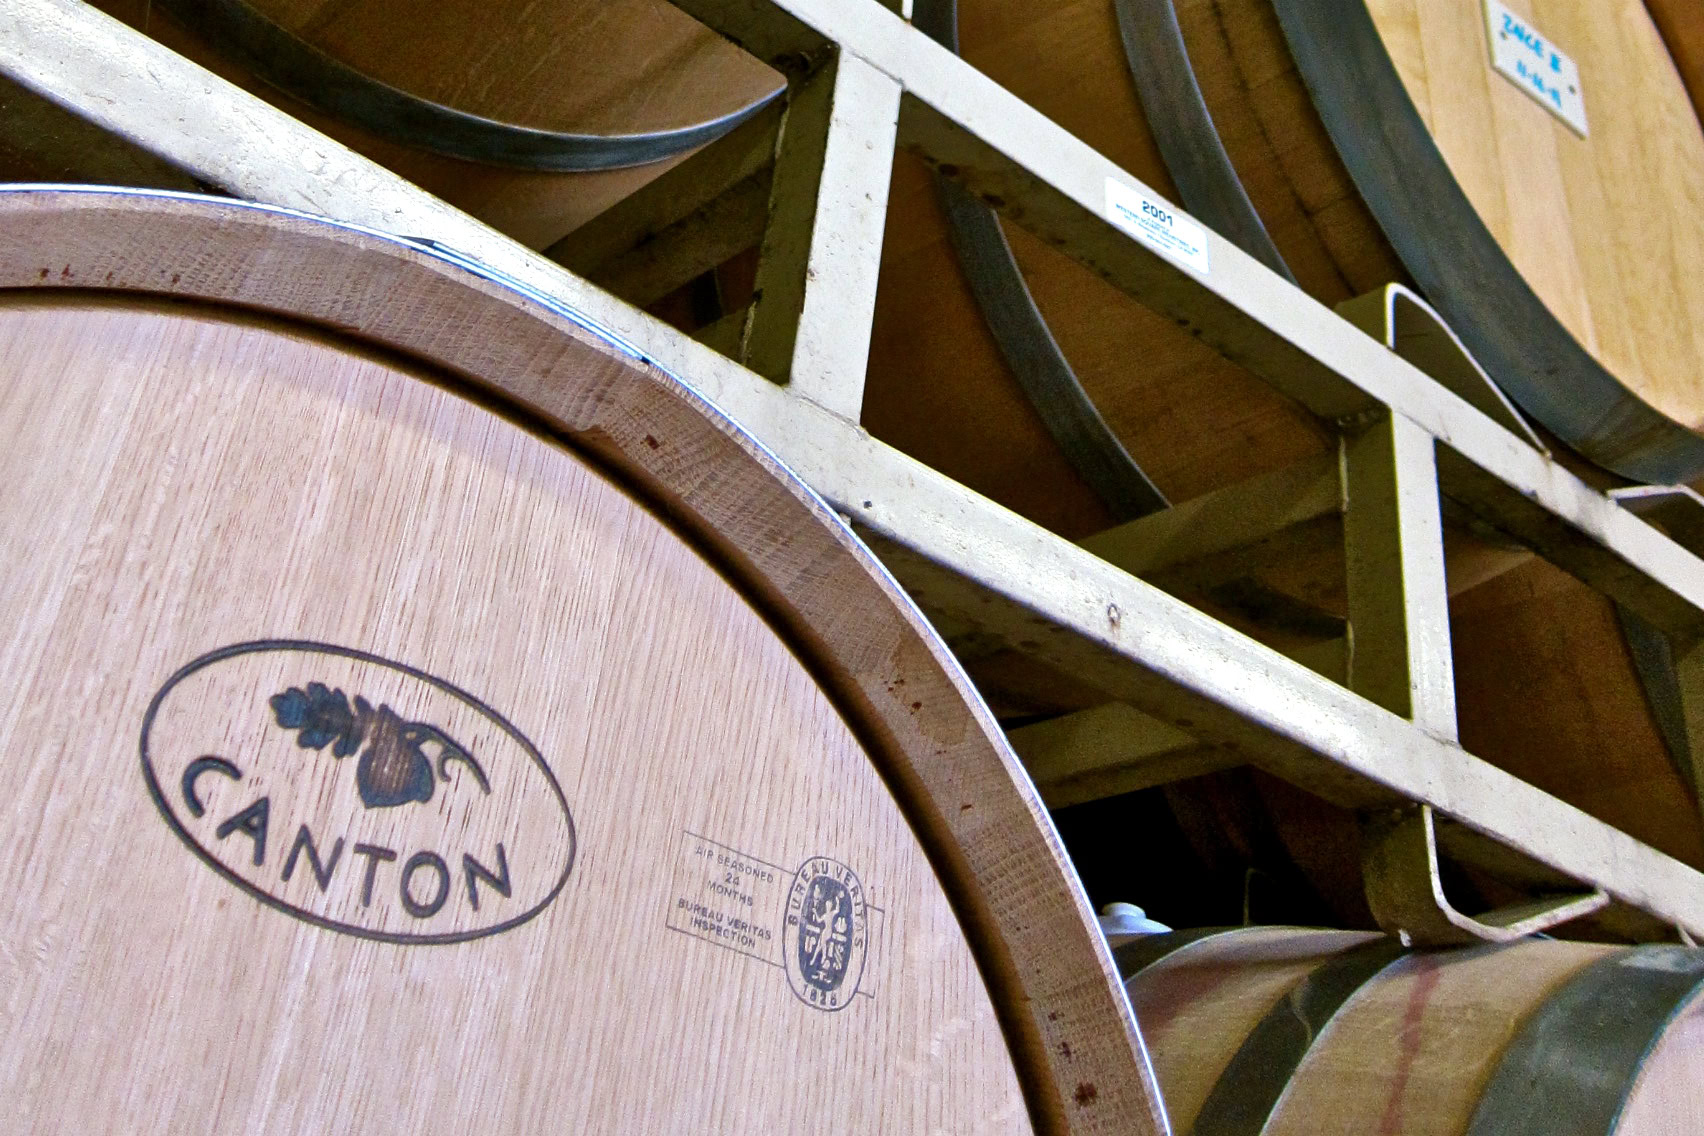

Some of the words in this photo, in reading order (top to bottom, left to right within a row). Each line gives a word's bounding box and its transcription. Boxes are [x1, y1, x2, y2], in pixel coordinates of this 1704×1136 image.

[1141, 199, 1174, 227] 2001
[181, 754, 514, 920] CANTON
[695, 845, 714, 860] AIR
[717, 853, 775, 884] SEASONED
[724, 872, 741, 886] 24
[706, 879, 754, 907] MONTHS
[788, 860, 829, 926] BUREAU
[835, 865, 864, 950] VERITAS
[678, 897, 724, 923] BUREAU
[727, 915, 772, 941] VERITAS
[689, 916, 757, 949] INSPECTION
